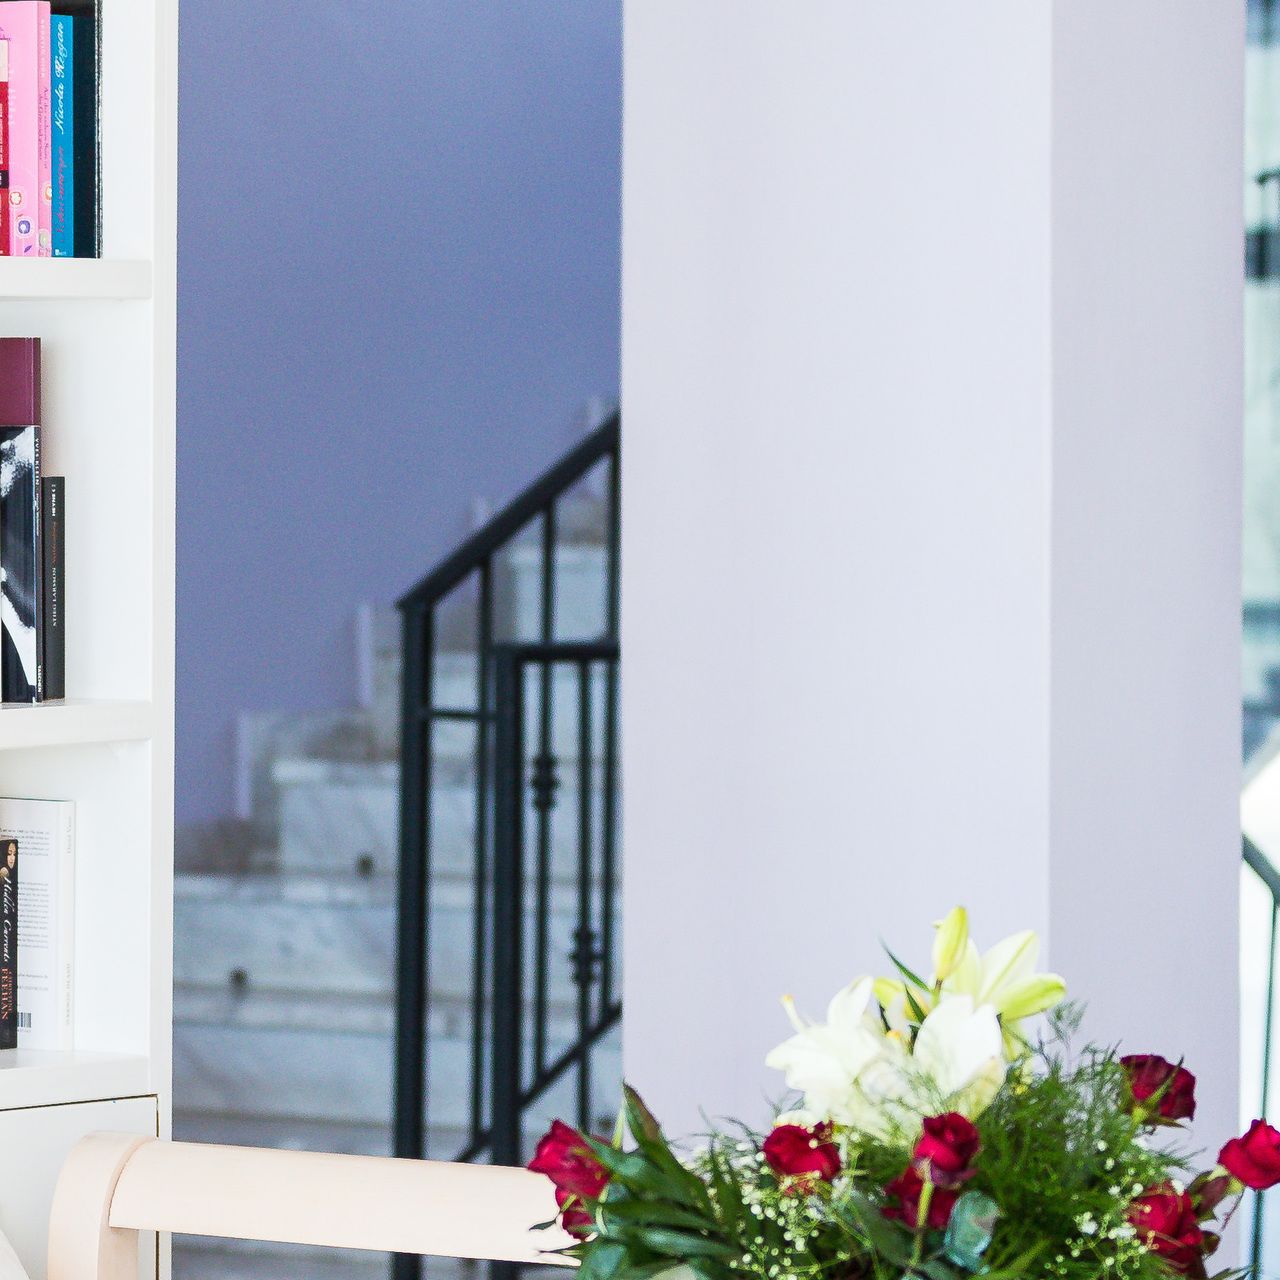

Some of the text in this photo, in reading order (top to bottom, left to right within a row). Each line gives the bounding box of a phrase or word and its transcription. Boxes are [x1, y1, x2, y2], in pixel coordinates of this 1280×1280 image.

[54, 21, 66, 78] Keegan
[53, 82, 65, 135] Nicola
[3, 875, 16, 964] Hidden Currents
[1, 966, 9, 1021] FEEHAN
